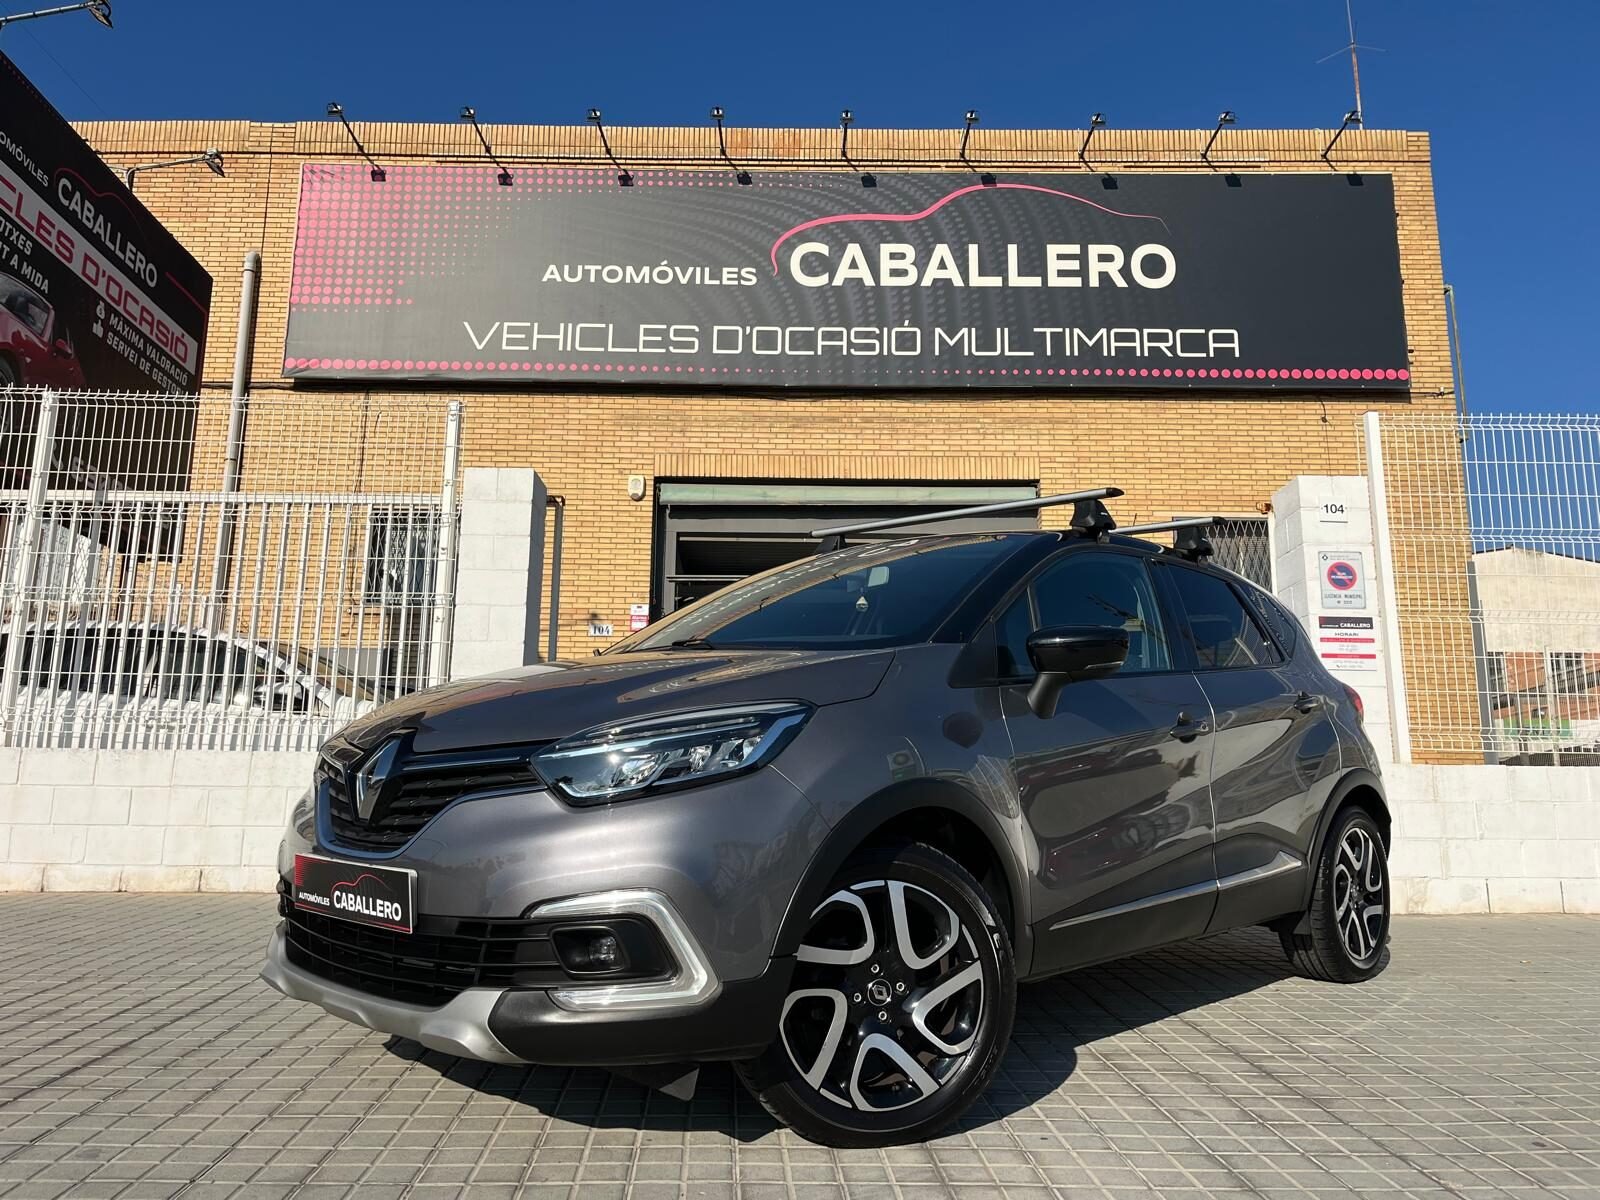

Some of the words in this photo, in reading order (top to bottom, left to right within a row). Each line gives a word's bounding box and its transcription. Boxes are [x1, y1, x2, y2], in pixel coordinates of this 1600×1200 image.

[57, 178, 158, 288] CABALLERO
[21, 261, 49, 294] MIDA
[542, 260, 758, 287] AUTOMÓVILES
[789, 241, 1177, 290] CABALLERO
[81, 252, 188, 364] D'OCASIÓ
[106, 332, 138, 365] SERVEI
[139, 357, 151, 375] DE
[463, 321, 700, 355] VEHICLES
[713, 319, 922, 358] D'OCASIÓ
[935, 327, 1240, 359] MULTIMARCA
[146, 343, 188, 386] VALORACIÓ
[1323, 504, 1345, 514] 104
[298, 892, 330, 906] AUTOMÓVILES
[333, 890, 402, 921] CABALLERO
